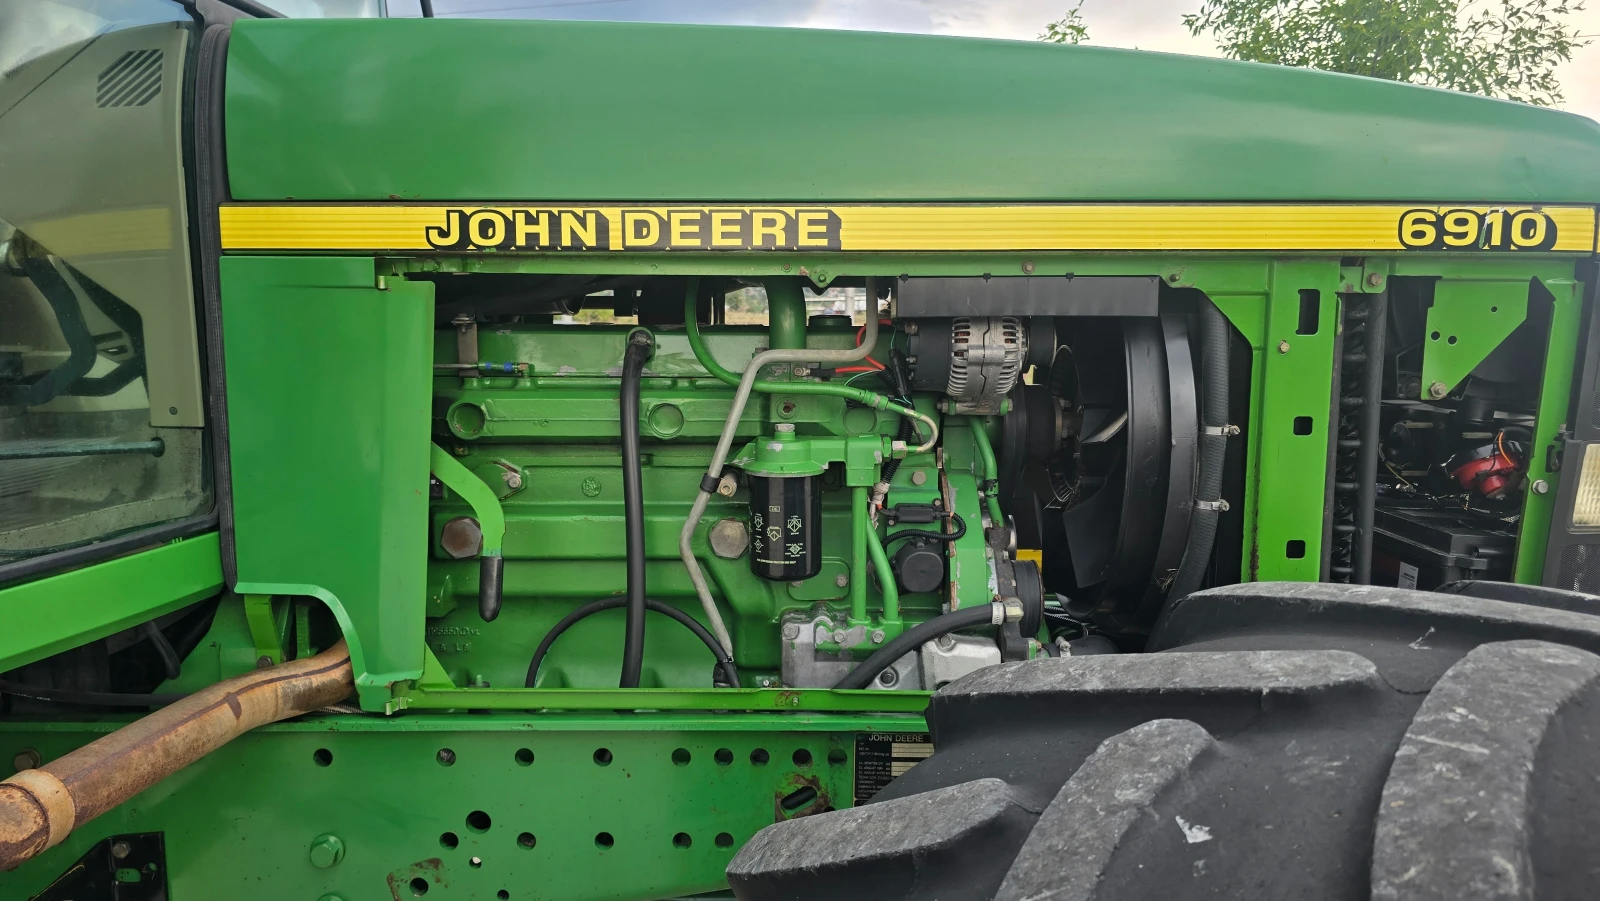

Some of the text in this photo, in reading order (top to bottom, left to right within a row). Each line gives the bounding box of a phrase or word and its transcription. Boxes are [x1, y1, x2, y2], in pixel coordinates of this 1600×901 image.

[426, 210, 835, 249] JOHN DEERE
[1399, 210, 1552, 249] 6910
[868, 734, 924, 743] JOHN DEERE
